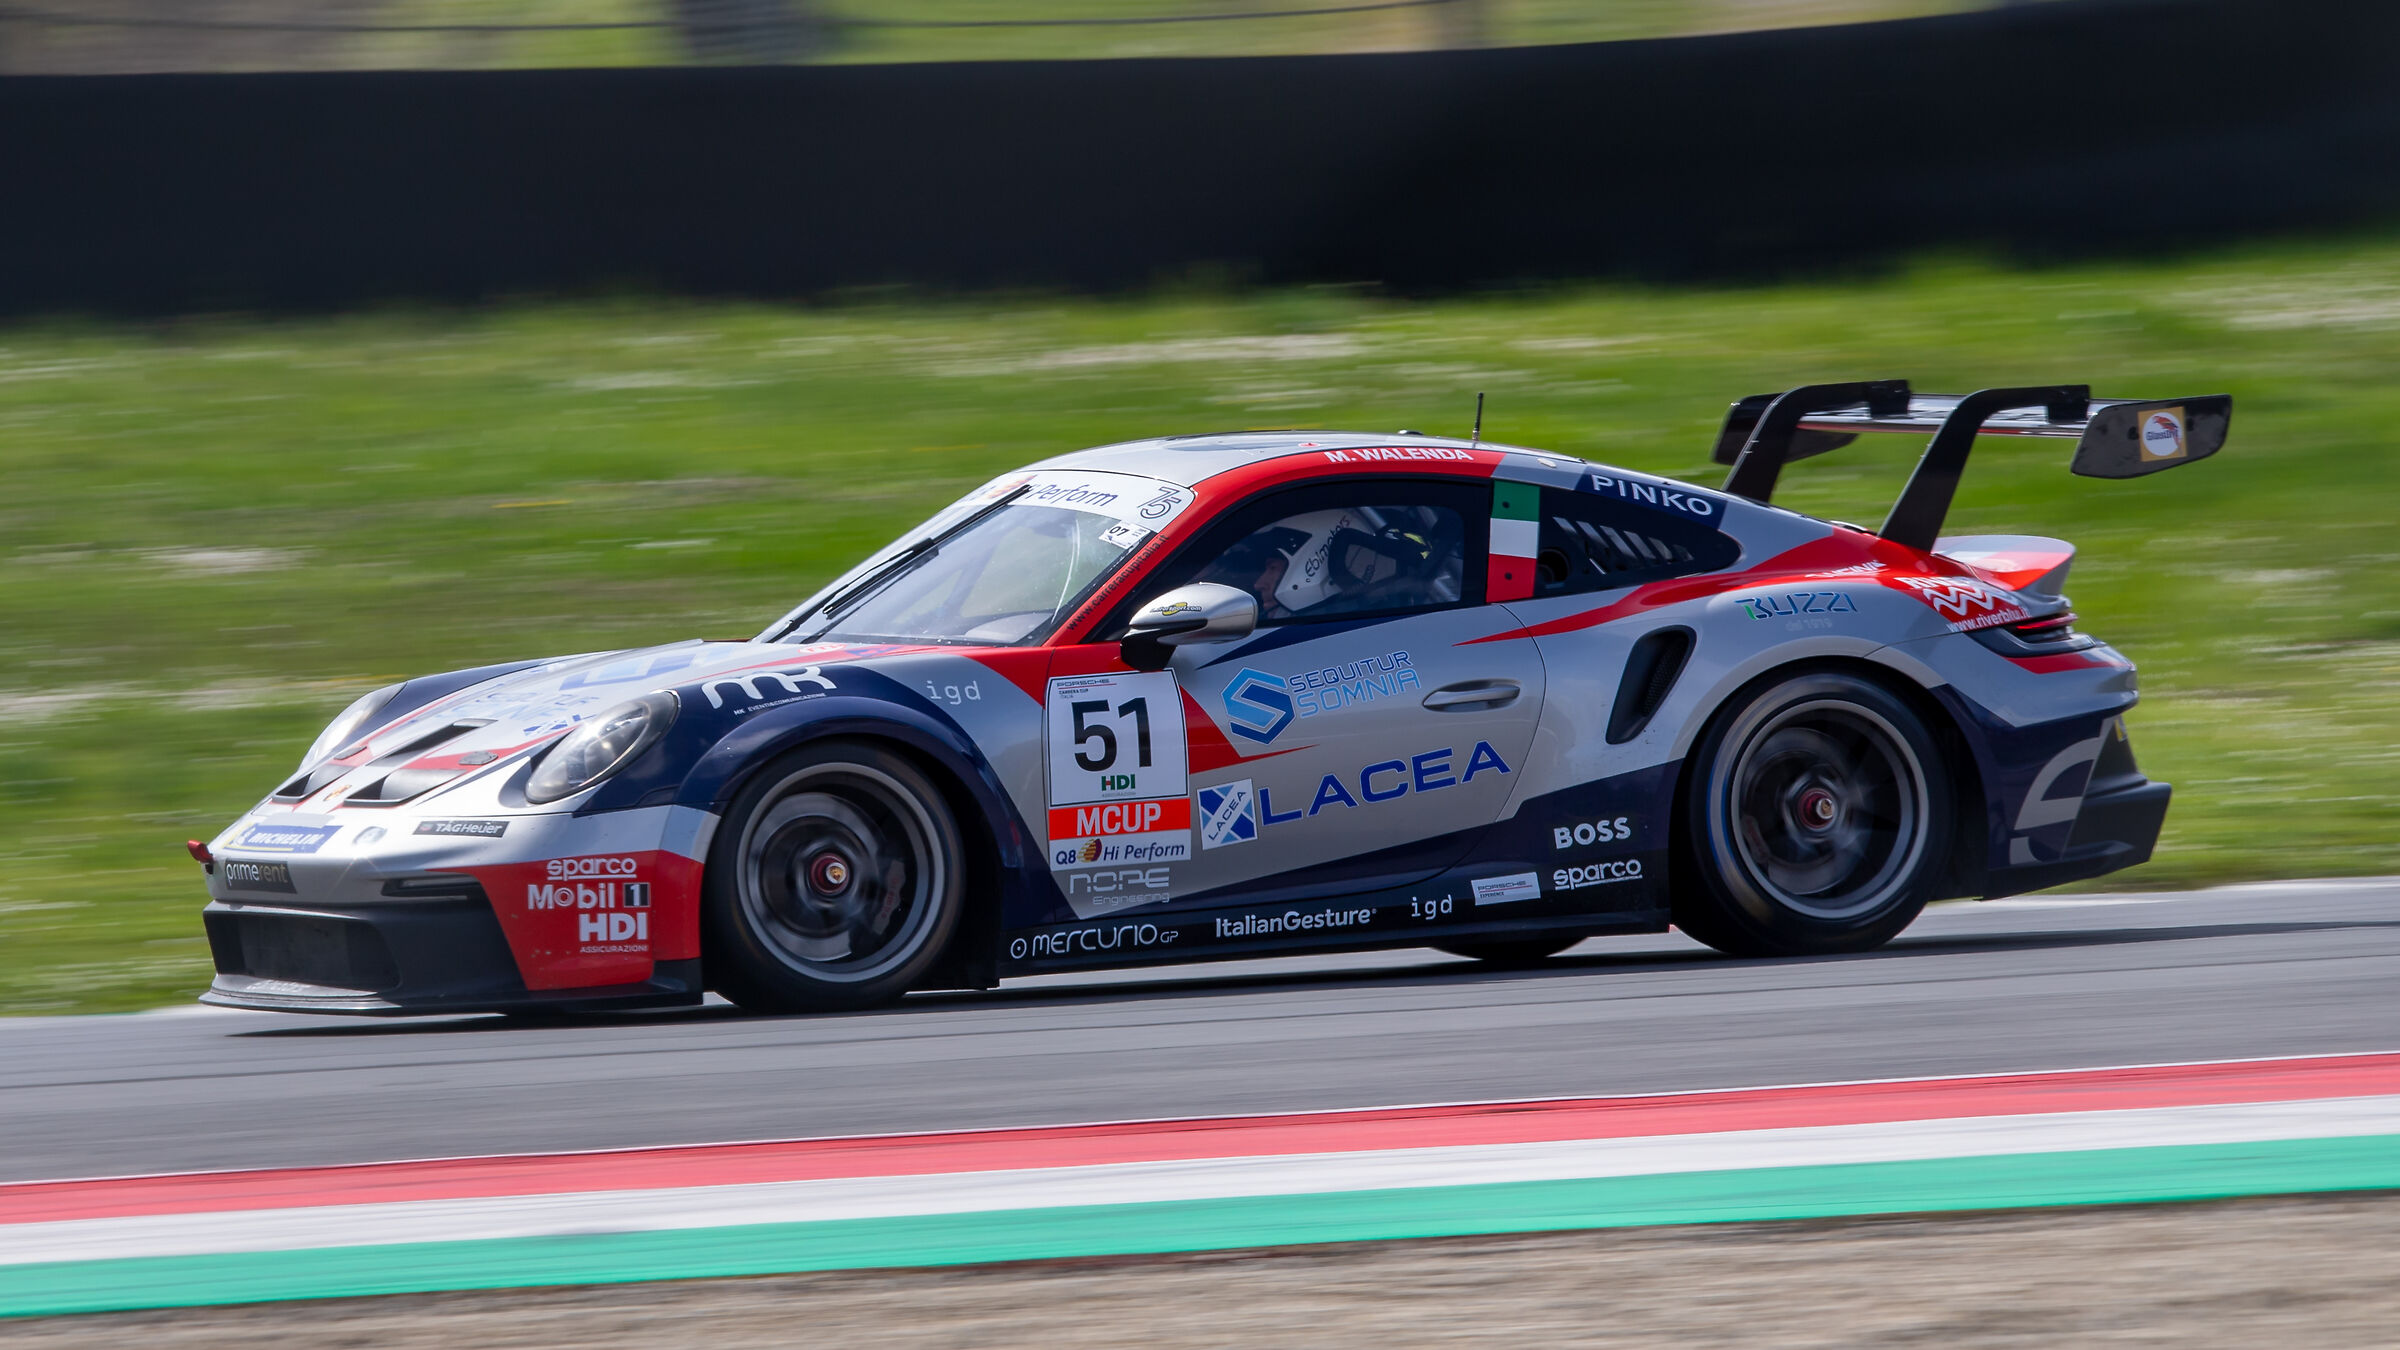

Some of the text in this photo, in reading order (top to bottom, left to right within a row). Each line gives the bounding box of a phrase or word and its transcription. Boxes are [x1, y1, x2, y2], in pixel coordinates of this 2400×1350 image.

[1324, 448, 1474, 463] M. WALENDA
[1591, 474, 1712, 515] PINKO
[1109, 526, 1130, 537] 07
[1066, 533, 1171, 631] www.carreracupitalia.it
[1735, 592, 1858, 620] BUZZI
[1946, 606, 2033, 632] www.riverblu.it
[1057, 678, 1110, 688] PORSCHE
[1289, 650, 1413, 693] SEQUITUR
[925, 680, 981, 705] igd
[1297, 668, 1421, 718] SOMNIA
[1071, 697, 1152, 772] 51
[1101, 774, 1136, 791] HDI
[1258, 739, 1512, 826] LACEA
[1076, 803, 1162, 837] MCUP
[1208, 790, 1246, 841] LACEA
[248, 832, 326, 845] MICHELIN
[1553, 816, 1632, 849] BOSS
[1056, 842, 1185, 865] Q8 Hi Perform
[547, 857, 637, 881] sparco
[1553, 859, 1643, 890] sparco
[527, 882, 641, 910] Mobil 1
[1093, 892, 1170, 905] Engineering
[1477, 880, 1527, 891] PORSCHE
[1411, 894, 1453, 920] igd
[579, 912, 648, 942] HDI
[1032, 924, 1179, 957] MERCURIO GP
[580, 945, 649, 953] ASSICURAZIONI
